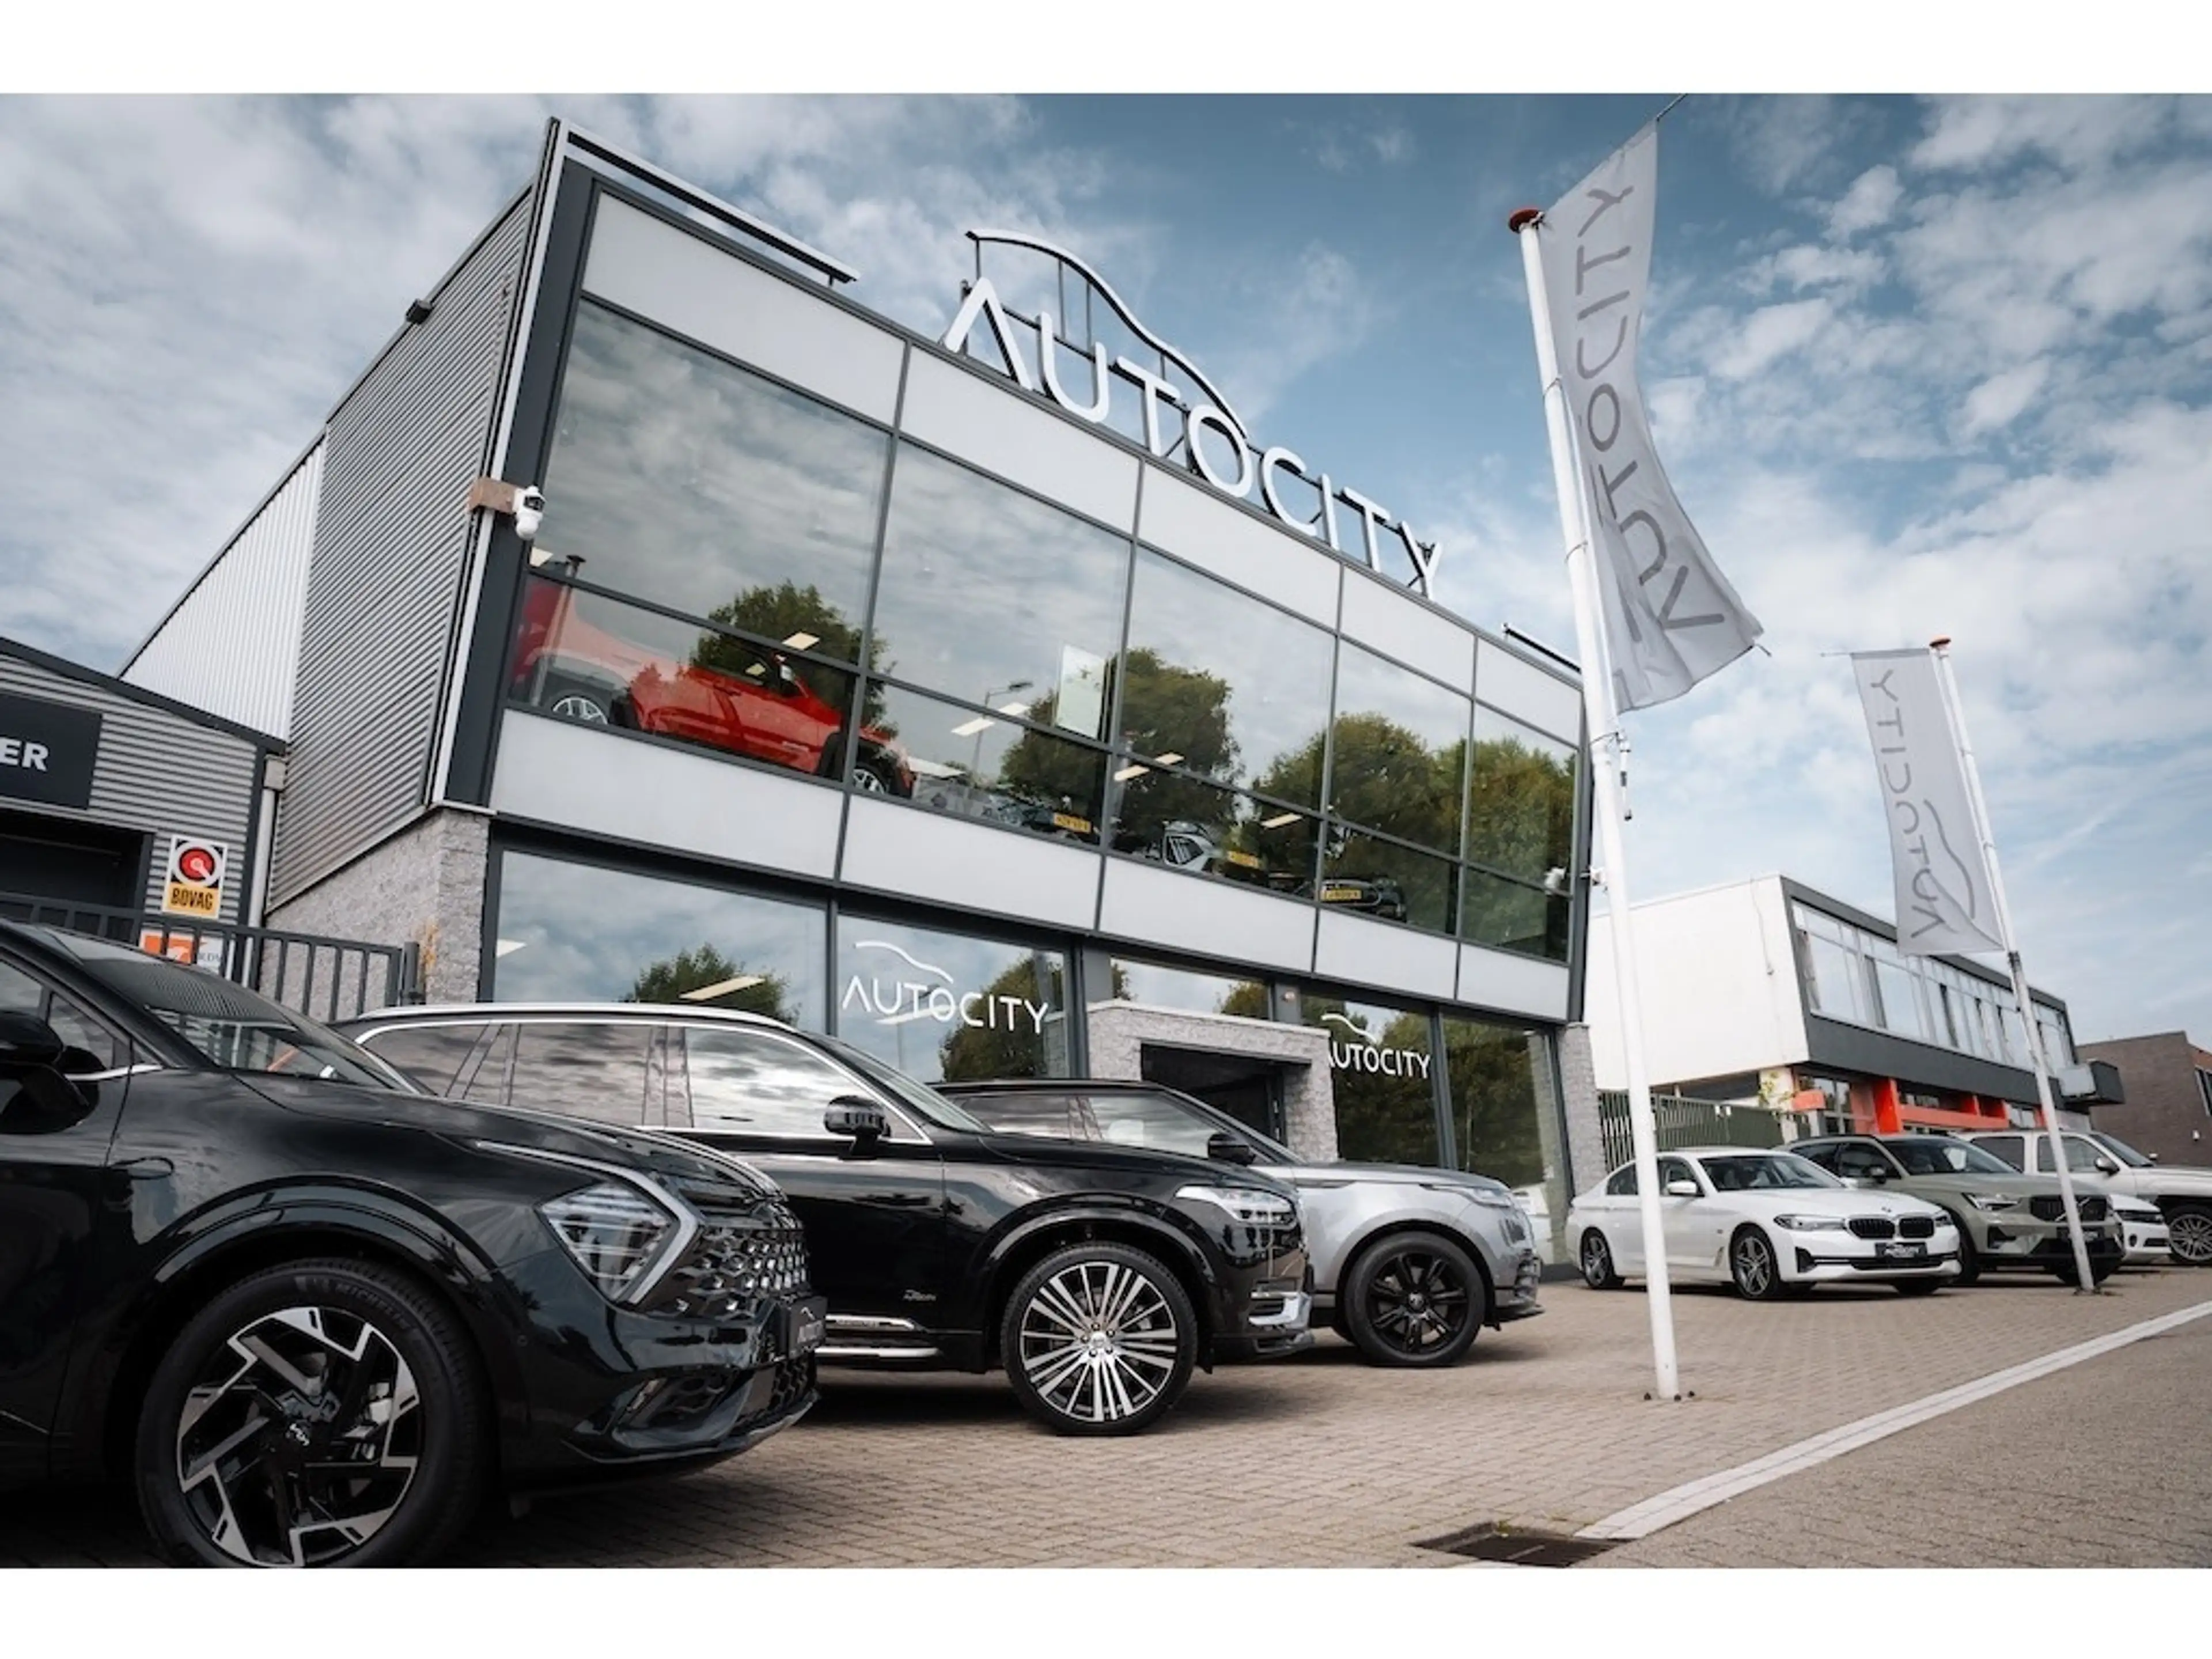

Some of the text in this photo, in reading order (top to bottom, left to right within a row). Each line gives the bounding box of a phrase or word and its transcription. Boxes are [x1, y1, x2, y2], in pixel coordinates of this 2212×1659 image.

[1576, 185, 1725, 630] AUTOCITY
[941, 277, 1444, 600] AUTOCITY
[0, 737, 49, 772] ER
[171, 888, 213, 911] BOVAG
[842, 975, 1048, 1035] AUTOCITY
[1328, 1041, 1431, 1079] UTOCITY
